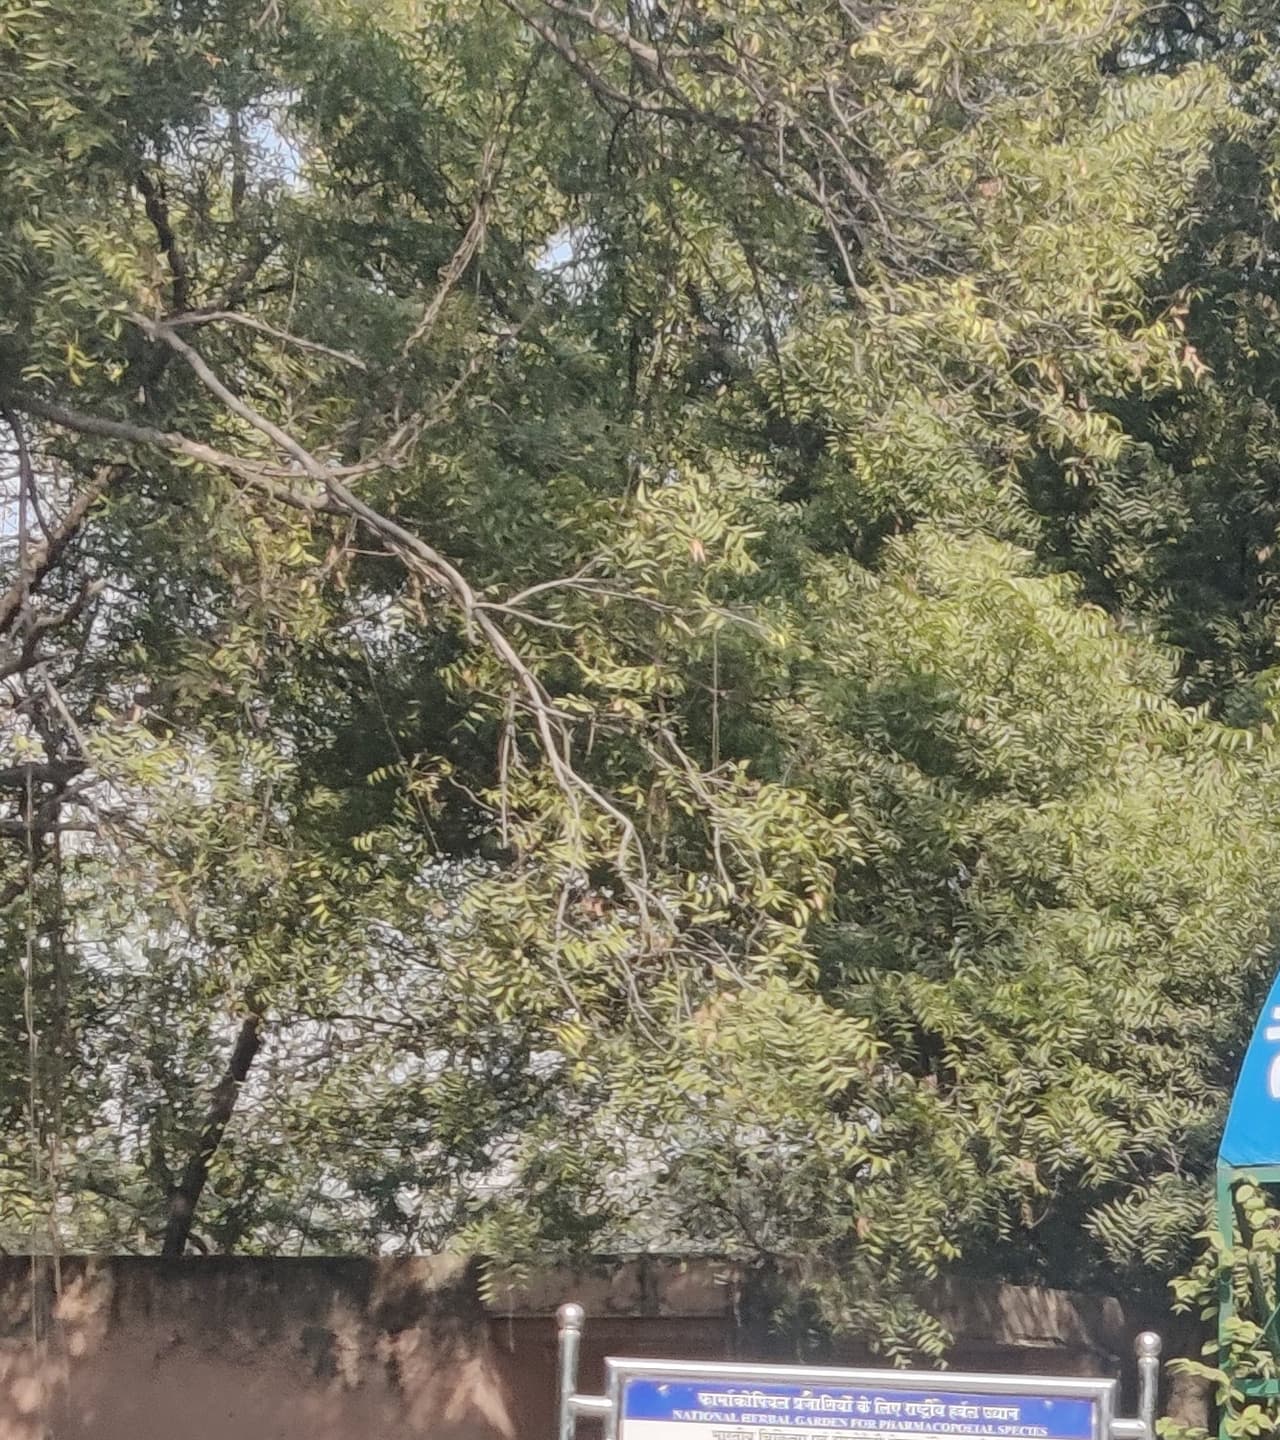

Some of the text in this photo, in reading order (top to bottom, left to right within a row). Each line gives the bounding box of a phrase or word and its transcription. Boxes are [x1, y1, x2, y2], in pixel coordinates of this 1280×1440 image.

[672, 1409, 741, 1423] NATIONAL
[742, 1412, 792, 1425] HERBAL
[795, 1415, 848, 1427] GARDEN
[850, 1418, 877, 1430] FOR
[998, 1424, 1049, 1437] SPECIES
